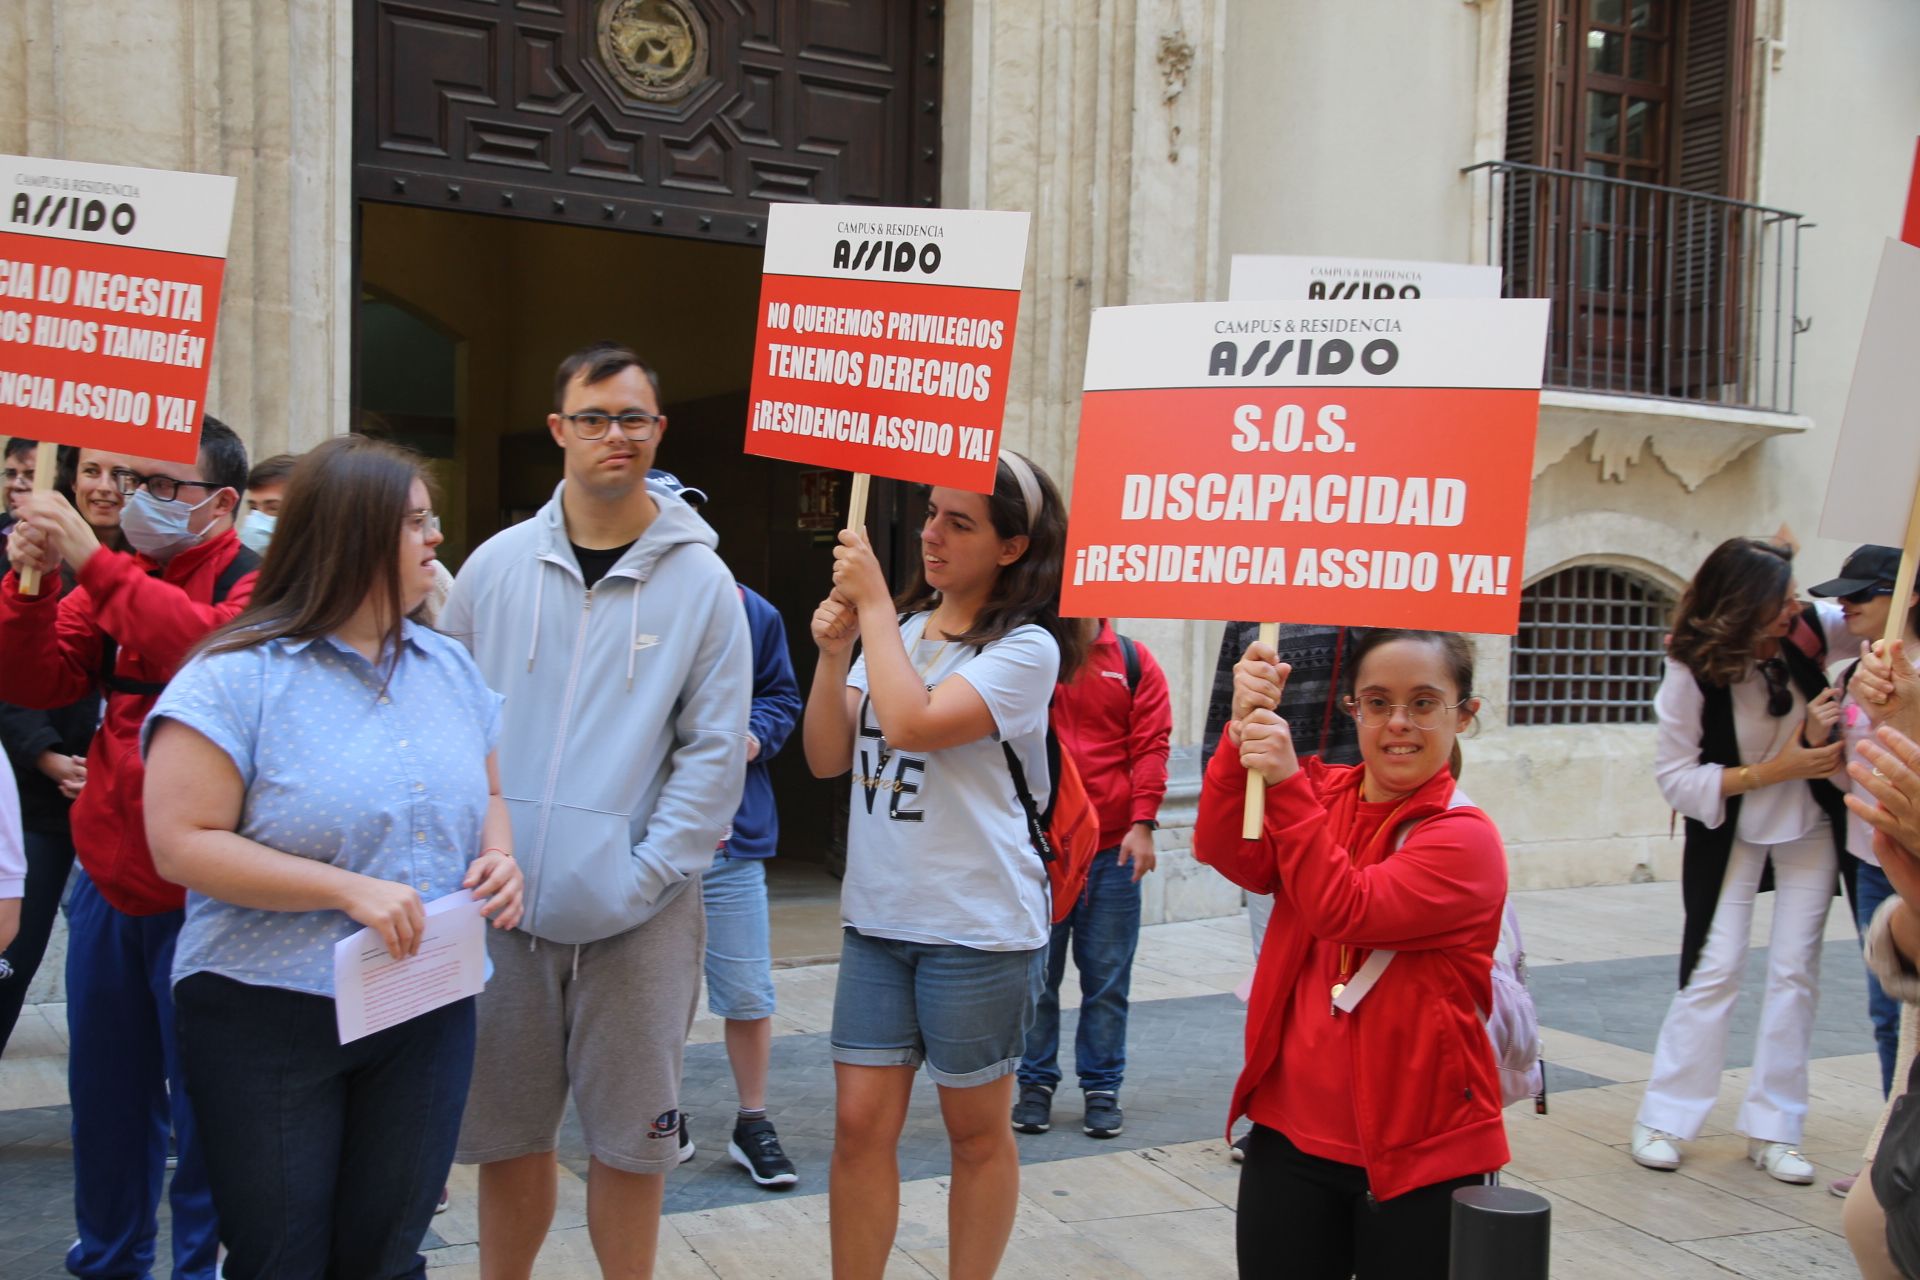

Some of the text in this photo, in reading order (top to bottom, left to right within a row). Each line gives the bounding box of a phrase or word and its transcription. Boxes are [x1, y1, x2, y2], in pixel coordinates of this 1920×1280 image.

[11, 192, 136, 235] ASSIDO
[837, 221, 945, 238] CAMPUS & RESIDENCIA
[833, 239, 942, 275] ASSIDO
[38, 265, 72, 304] LO
[73, 269, 203, 322] NECESITA
[1308, 280, 1421, 300] ASSIDO
[0, 310, 206, 368] OS HIJOS TAMBIÉN
[767, 302, 1004, 350] NO QUEREMOS PRIVILEGIOS
[1214, 318, 1402, 334] CAMPUS & RESIDENCIA
[768, 343, 992, 402] TENEMOS DERECHOS
[1208, 338, 1399, 377] ASSIDO
[57, 381, 151, 426] ASSIDO
[156, 395, 197, 433] YA!
[752, 400, 994, 463] ¡RESIDENCIA ASSIDO YA!
[1231, 404, 1356, 453] S.O.S.
[1121, 472, 1467, 527] DISCAPACIDAD
[1073, 544, 1512, 595] ¡RESIDENCIA ASSIDO YA!
